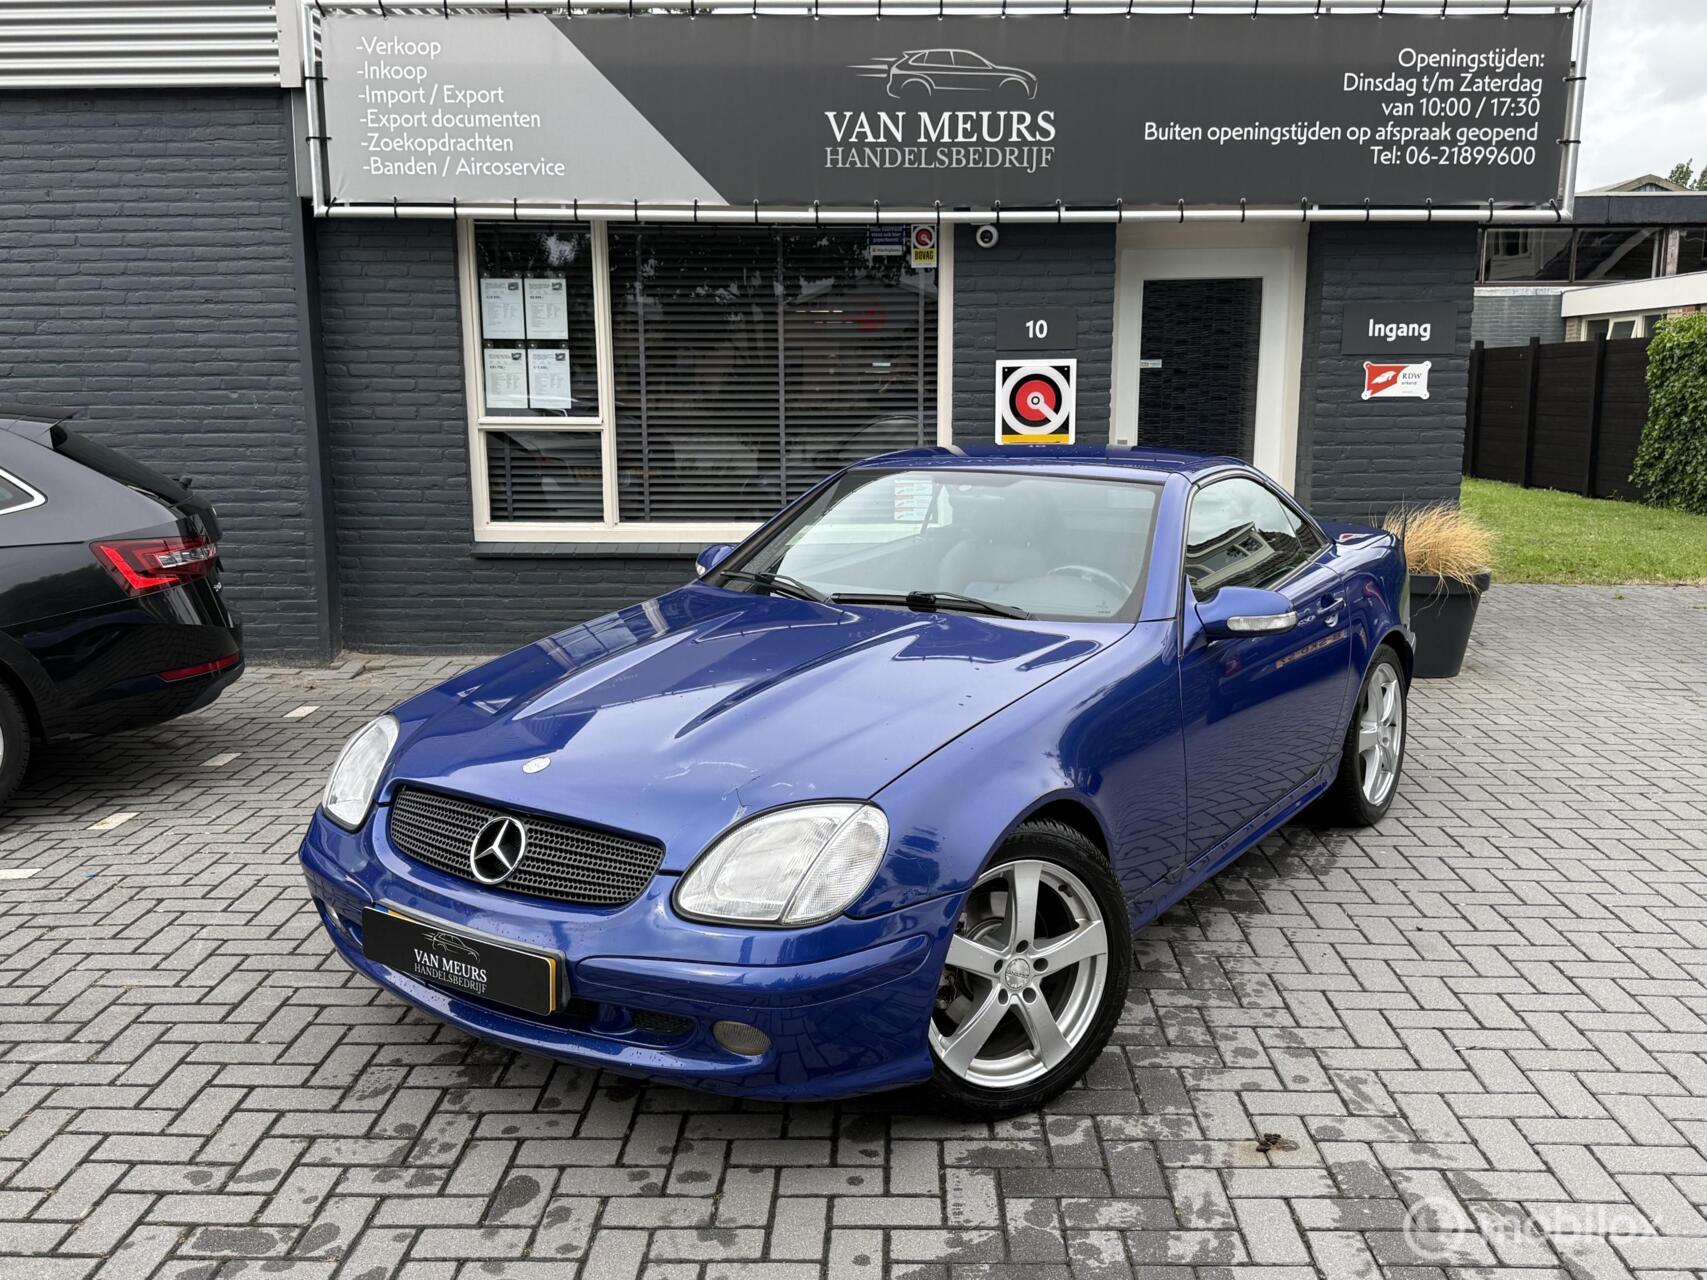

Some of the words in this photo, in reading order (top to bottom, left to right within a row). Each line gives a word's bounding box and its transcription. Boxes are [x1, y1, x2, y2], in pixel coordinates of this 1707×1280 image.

[356, 35, 441, 59] -Verkoop
[1398, 47, 1545, 72] Openingstijden:
[357, 61, 427, 83] -Inkoop
[1343, 72, 1416, 95] Dinsdag
[1422, 72, 1455, 92] t/m
[1460, 71, 1543, 95] Zaterdag
[359, 85, 425, 108] -Import
[430, 84, 438, 104] /
[444, 85, 504, 108] Export
[1381, 101, 1414, 116] van
[1419, 97, 1471, 116] 10:00
[1476, 97, 1486, 118] /
[1490, 96, 1540, 116] 17:30
[360, 109, 428, 131] -Export
[432, 109, 541, 128] documenten
[824, 111, 906, 143] VAN
[917, 110, 1056, 143] MEURS
[361, 133, 513, 155] -Zoekopdrachten
[1144, 121, 1202, 140] Buiten
[1207, 121, 1341, 144] openingstijden
[1347, 126, 1371, 144] op
[1375, 121, 1451, 144] afspraak
[1457, 122, 1538, 144] geopend
[363, 156, 438, 175] -Banden
[442, 156, 451, 177] /
[456, 157, 566, 176] Aircoservice
[824, 146, 1055, 173] HANDELSBEDRIJF
[1370, 146, 1401, 164] Tel:
[1405, 146, 1536, 165] 06-21899600
[1025, 319, 1048, 339] 10
[1368, 318, 1432, 342] Ingang
[1402, 372, 1422, 380] RDW
[414, 949, 439, 968] VAN
[442, 957, 487, 982] MEURS
[414, 963, 487, 993] HANDELSBEDRIJF
